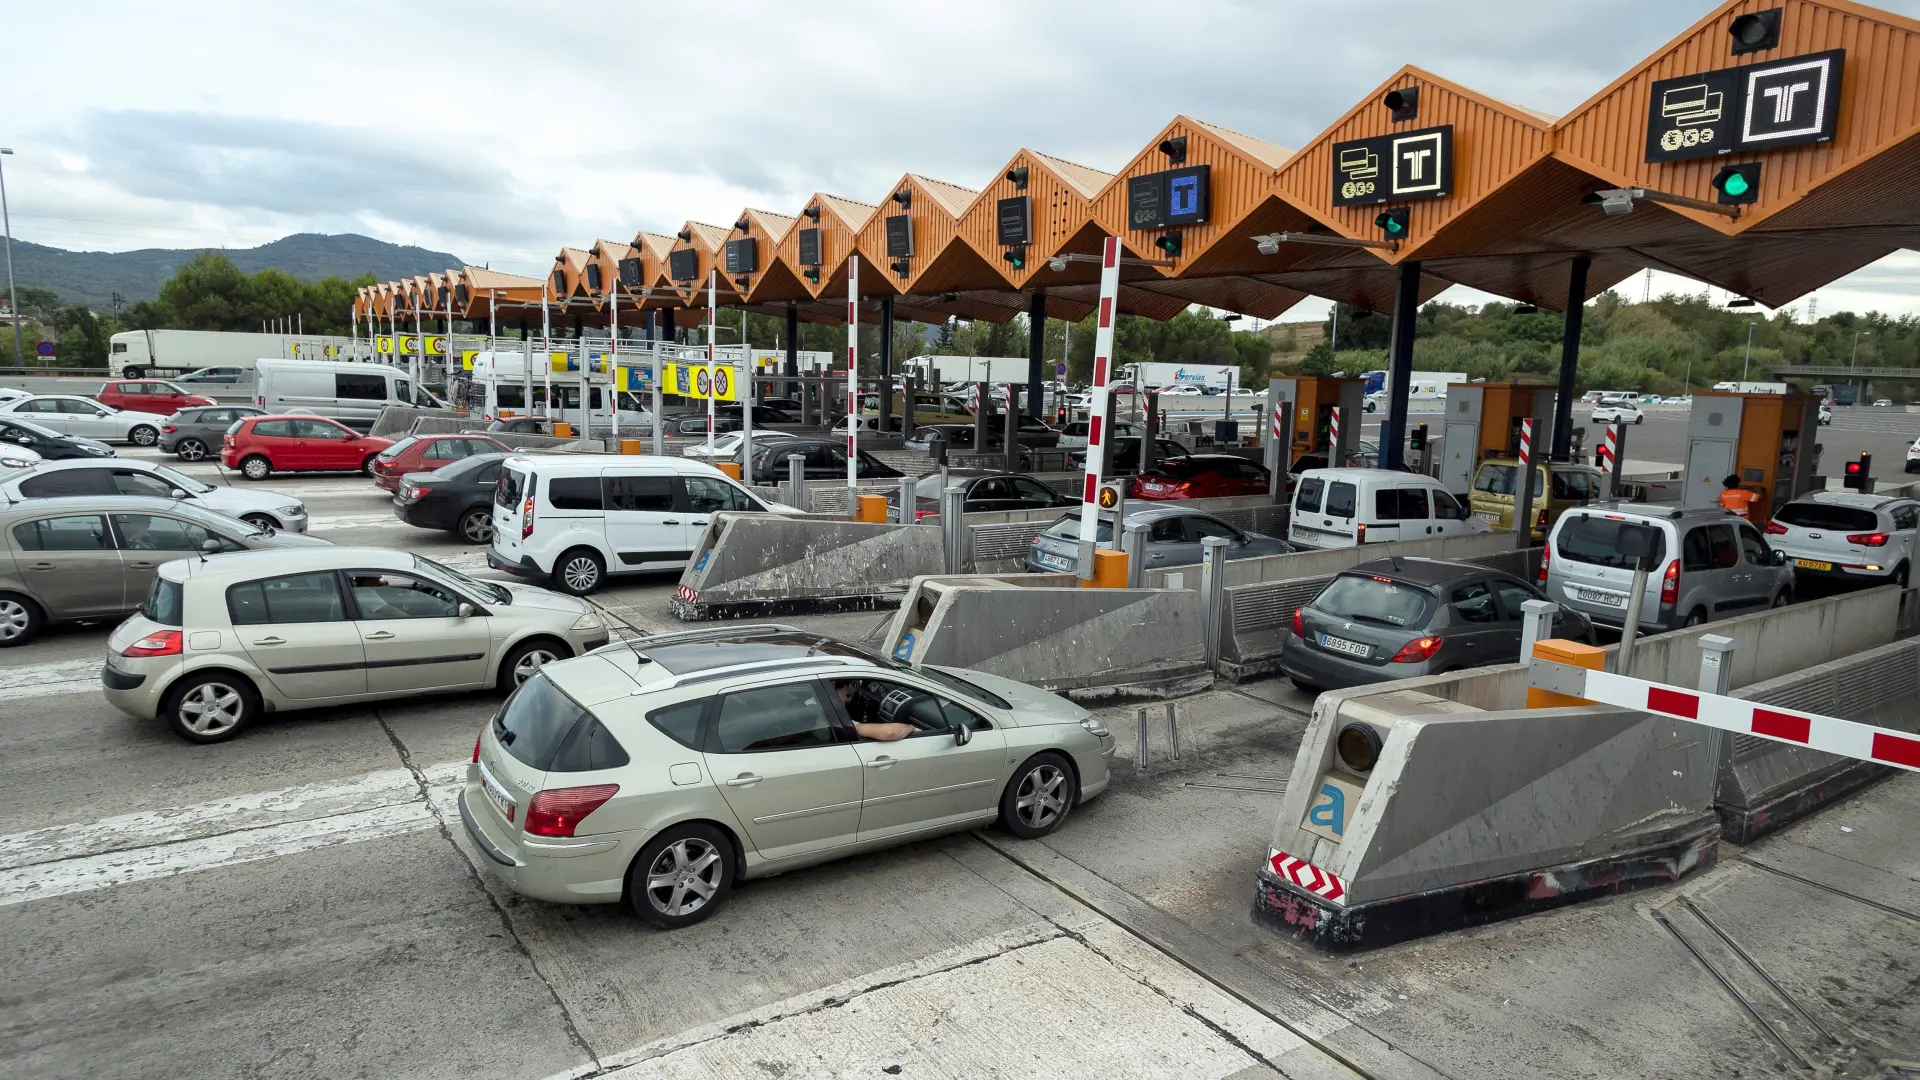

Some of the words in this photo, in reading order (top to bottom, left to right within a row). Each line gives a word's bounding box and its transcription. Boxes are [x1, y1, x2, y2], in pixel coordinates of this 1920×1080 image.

[1582, 591, 1603, 600] 0097
[1327, 638, 1347, 650] 6895
[1350, 643, 1367, 655] FDB
[1310, 783, 1345, 836] a
